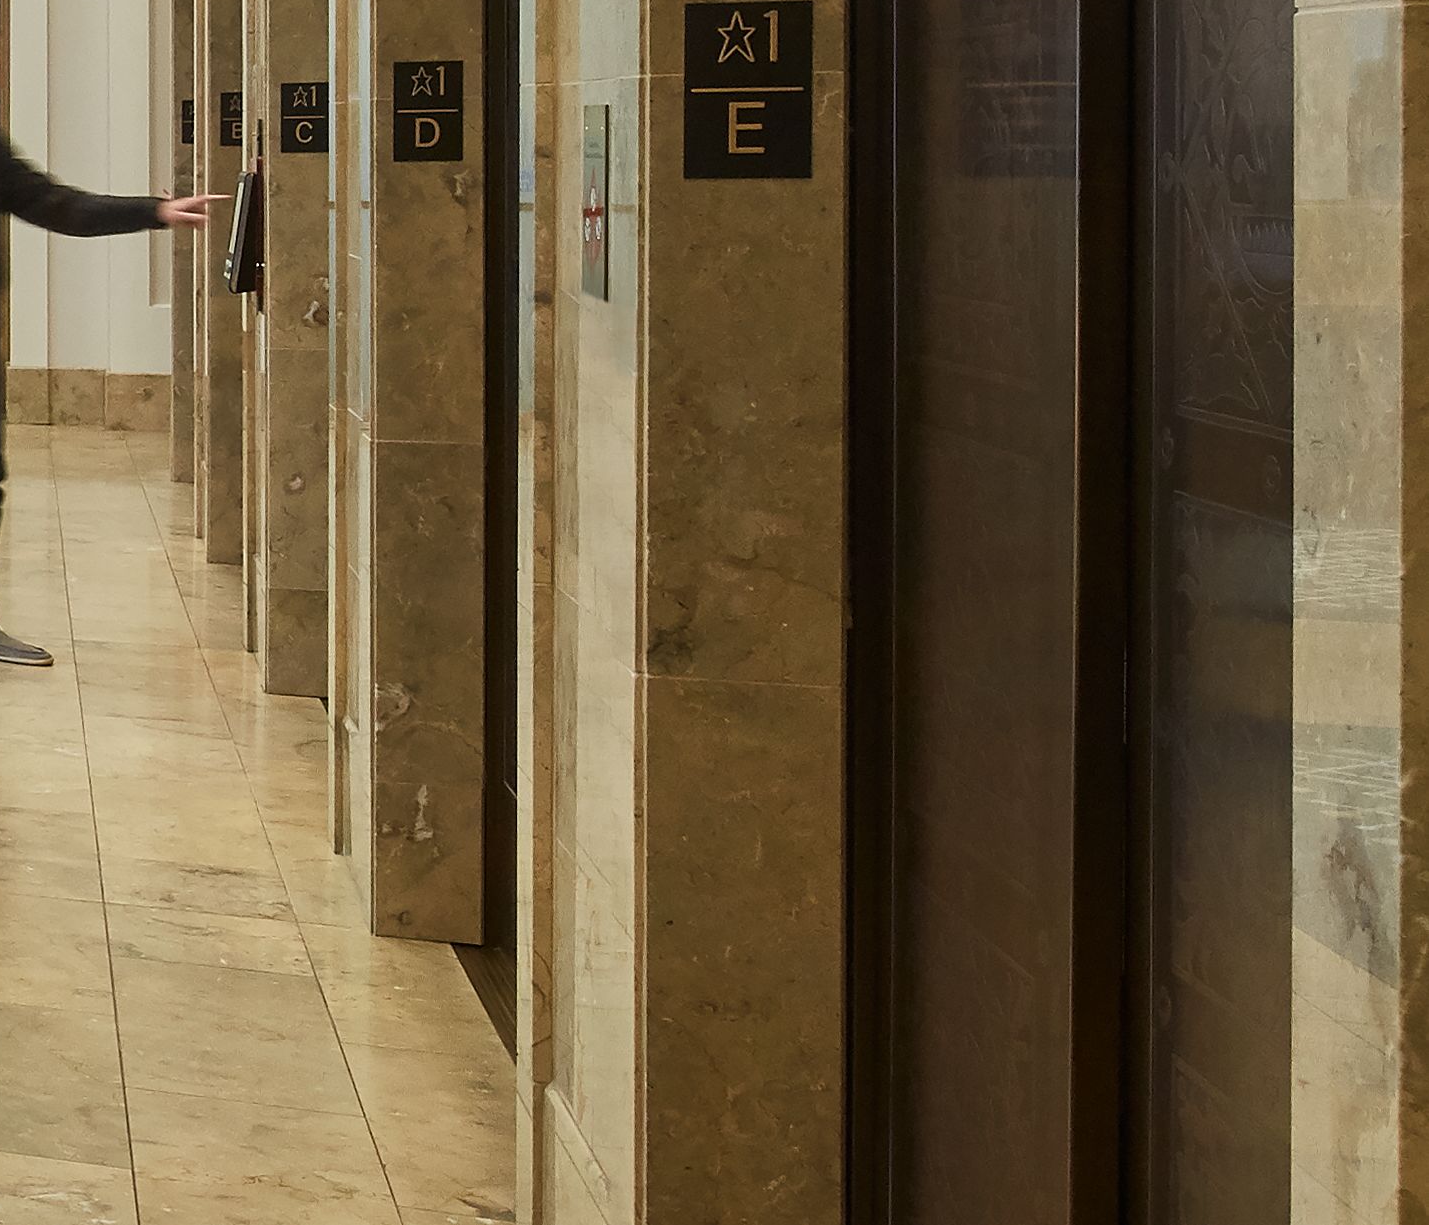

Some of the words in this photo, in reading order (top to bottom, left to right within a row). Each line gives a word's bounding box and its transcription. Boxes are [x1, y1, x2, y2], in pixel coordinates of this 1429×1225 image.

[295, 121, 313, 144] C
[415, 117, 441, 148] D
[728, 102, 765, 154] E
